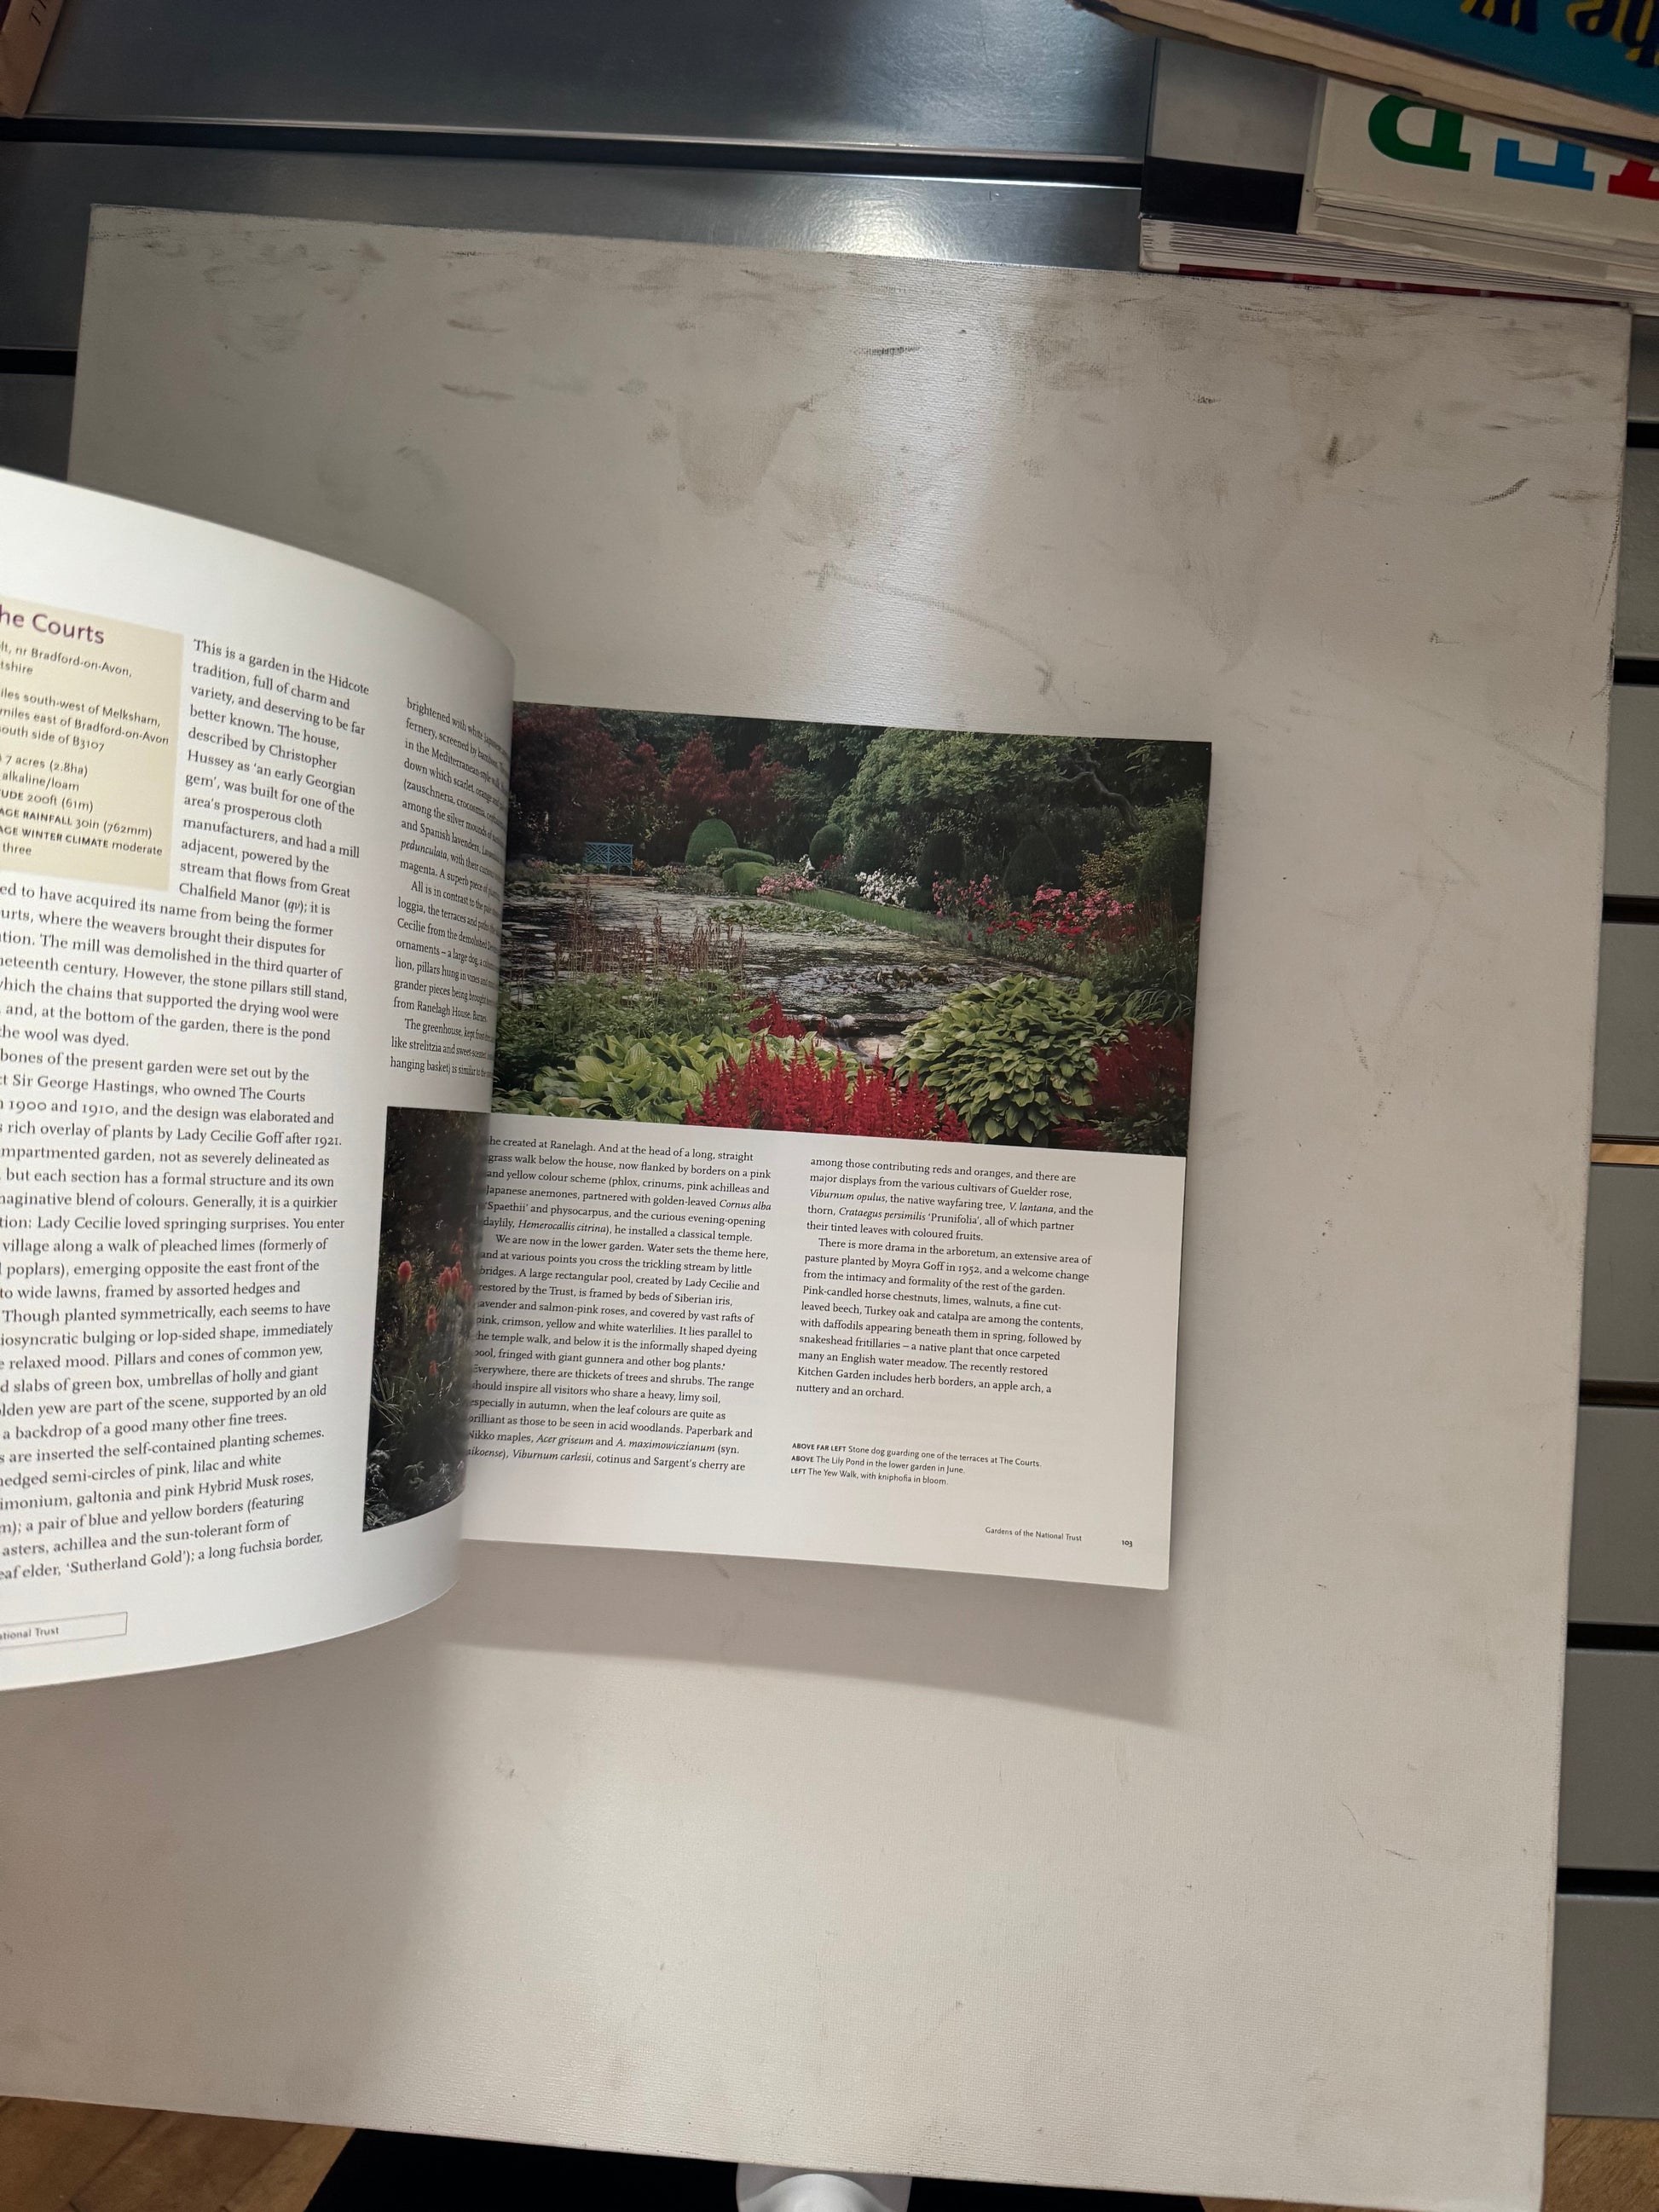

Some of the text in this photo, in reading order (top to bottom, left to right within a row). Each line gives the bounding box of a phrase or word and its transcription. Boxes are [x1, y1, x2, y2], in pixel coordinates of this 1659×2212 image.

[32, 614, 104, 644] Courts
[32, 648, 131, 678] Bradford-on-Avon,
[194, 638, 368, 695] This is a garden in the Hidcote
[193, 661, 350, 710] tradition, full of charm and
[24, 694, 84, 713] south-west
[89, 705, 101, 714] of
[102, 706, 160, 727] Melksham,
[191, 686, 365, 735] variety, and deserving to be far
[33, 713, 56, 725] east
[60, 717, 72, 727] of
[75, 718, 169, 745] Bradford-on-Avon
[190, 704, 338, 750] better known. The house,
[32, 730, 55, 742] side
[58, 734, 71, 744] of
[73, 735, 104, 752] B3107
[188, 726, 337, 769] described by Christopher
[6, 755, 87, 777] 7 acres (2.8ha)
[3, 770, 78, 791] alkaline/loam
[0, 789, 93, 814] UDE 200ft (61m)
[23, 811, 72, 825] RAINFALL
[76, 818, 99, 829] 30in
[104, 821, 152, 840] (762mm)
[3, 842, 32, 855] three
[22, 829, 62, 842] WINTER
[65, 835, 108, 848] CLIMATE
[113, 841, 162, 856] moderate
[394, 996, 414, 1009] from
[417, 1001, 450, 1018] Ranelagh
[0, 1048, 309, 1083] bones of the present garden were set out by the
[489, 1135, 501, 1145] he
[503, 1139, 536, 1147] created
[550, 1141, 595, 1153] Ranelagh.
[598, 1144, 618, 1152] And
[632, 1145, 646, 1154] the
[649, 1146, 671, 1156] head
[673, 1148, 684, 1157] of
[692, 1149, 715, 1161] long,
[718, 1152, 754, 1164] straight
[811, 1159, 842, 1170] among
[846, 1158, 870, 1169] those
[872, 1162, 929, 1175] contributing
[933, 1164, 951, 1174] reds
[955, 1166, 972, 1175] and
[974, 1170, 1013, 1180] oranges,
[1016, 1170, 1032, 1179] and
[1036, 1171, 1059, 1181] there
[796, 1384, 830, 1395] nuttery
[832, 1385, 849, 1395] and
[865, 1388, 904, 1398] orchard.
[798, 1366, 833, 1377] Kitchen
[835, 1369, 870, 1380] Garden
[873, 1372, 912, 1383] includes
[914, 1374, 936, 1384] herb
[939, 1376, 975, 1388] borders,
[992, 1381, 1018, 1392] apple
[1020, 1383, 1043, 1393] arch,
[832, 1456, 844, 1466] Lily
[846, 1458, 864, 1466] Pond
[889, 1460, 909, 1470] lower
[910, 1463, 936, 1472] garden
[946, 1465, 965, 1475] June.
[848, 1446, 870, 1454] Stone
[871, 1447, 885, 1458] dog
[887, 1449, 919, 1459] guarding
[960, 1454, 988, 1463] terraces
[839, 1470, 858, 1479] Walk,
[861, 1471, 876, 1480] with
[878, 1472, 911, 1482] kniphofia
[914, 1475, 921, 1483] in
[922, 1476, 948, 1485] bloom.
[986, 1527, 1013, 1535] Gardens
[1035, 1531, 1063, 1539] National
[1122, 1539, 1132, 1548] 103
[35, 1626, 59, 1637] Trust
